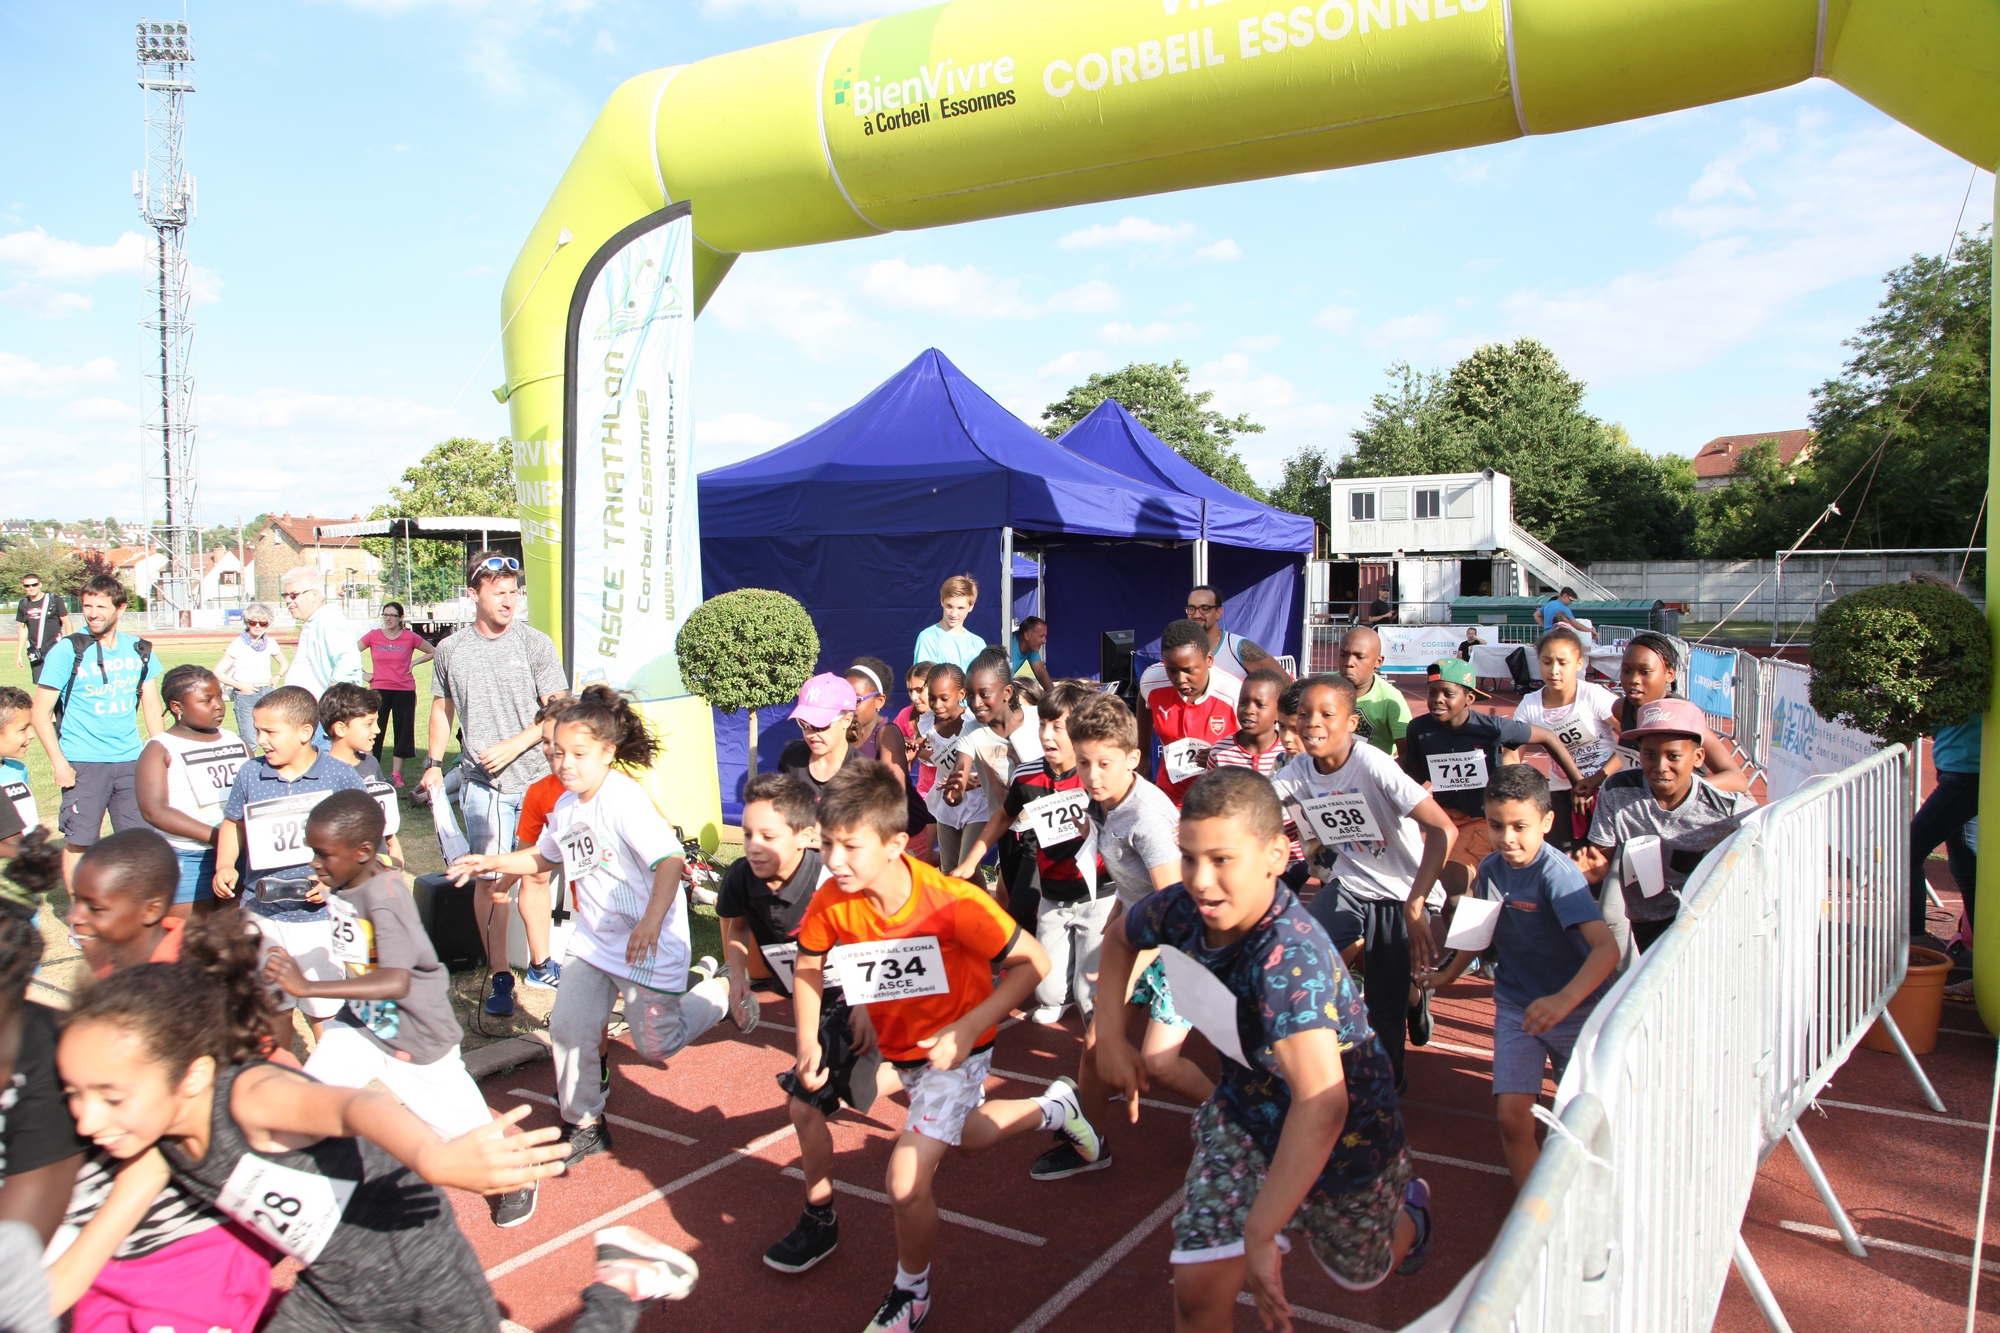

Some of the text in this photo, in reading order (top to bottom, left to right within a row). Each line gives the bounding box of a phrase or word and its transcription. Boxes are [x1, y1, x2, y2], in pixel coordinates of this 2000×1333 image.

[1043, 27, 1225, 97] CORBEIL
[853, 55, 1016, 117] BienVivre
[863, 89, 1017, 136] à Corbeil Essonnes
[637, 388, 653, 613] Corbeil-Essonnes
[598, 566, 625, 658] ASCE
[1559, 727, 1583, 745] 05
[214, 745, 245, 757] adidas
[1438, 763, 1478, 779] 712
[1040, 803, 1084, 829] 720
[1320, 808, 1366, 829] 638
[1338, 825, 1362, 835] ASCE
[567, 835, 595, 862] 719
[902, 944, 935, 953] EXONA
[856, 956, 927, 983] 734
[878, 978, 914, 991] ASCE
